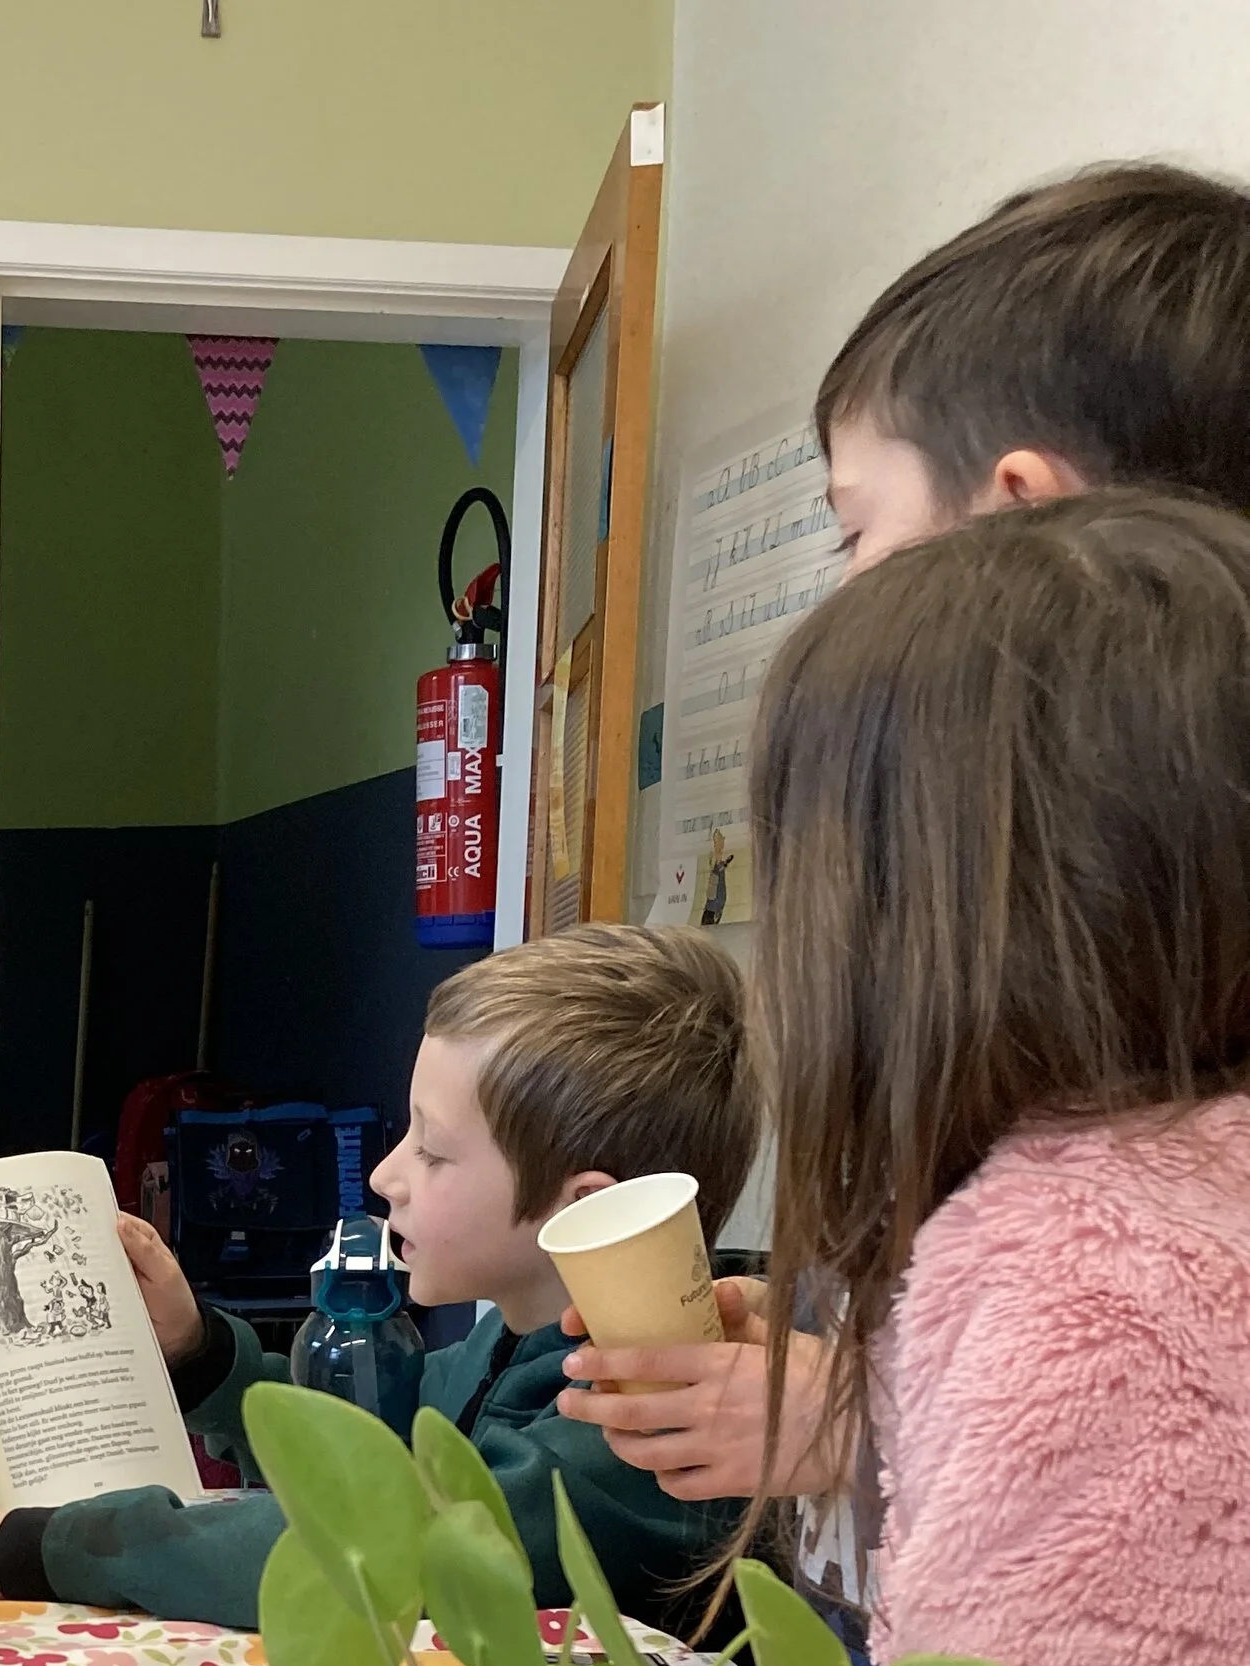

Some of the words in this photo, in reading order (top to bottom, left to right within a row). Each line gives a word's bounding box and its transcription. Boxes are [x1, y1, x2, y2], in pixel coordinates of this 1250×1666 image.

[465, 747, 482, 796] MAX
[464, 813, 482, 878] AQUA
[334, 1126, 367, 1218] FORTNITE
